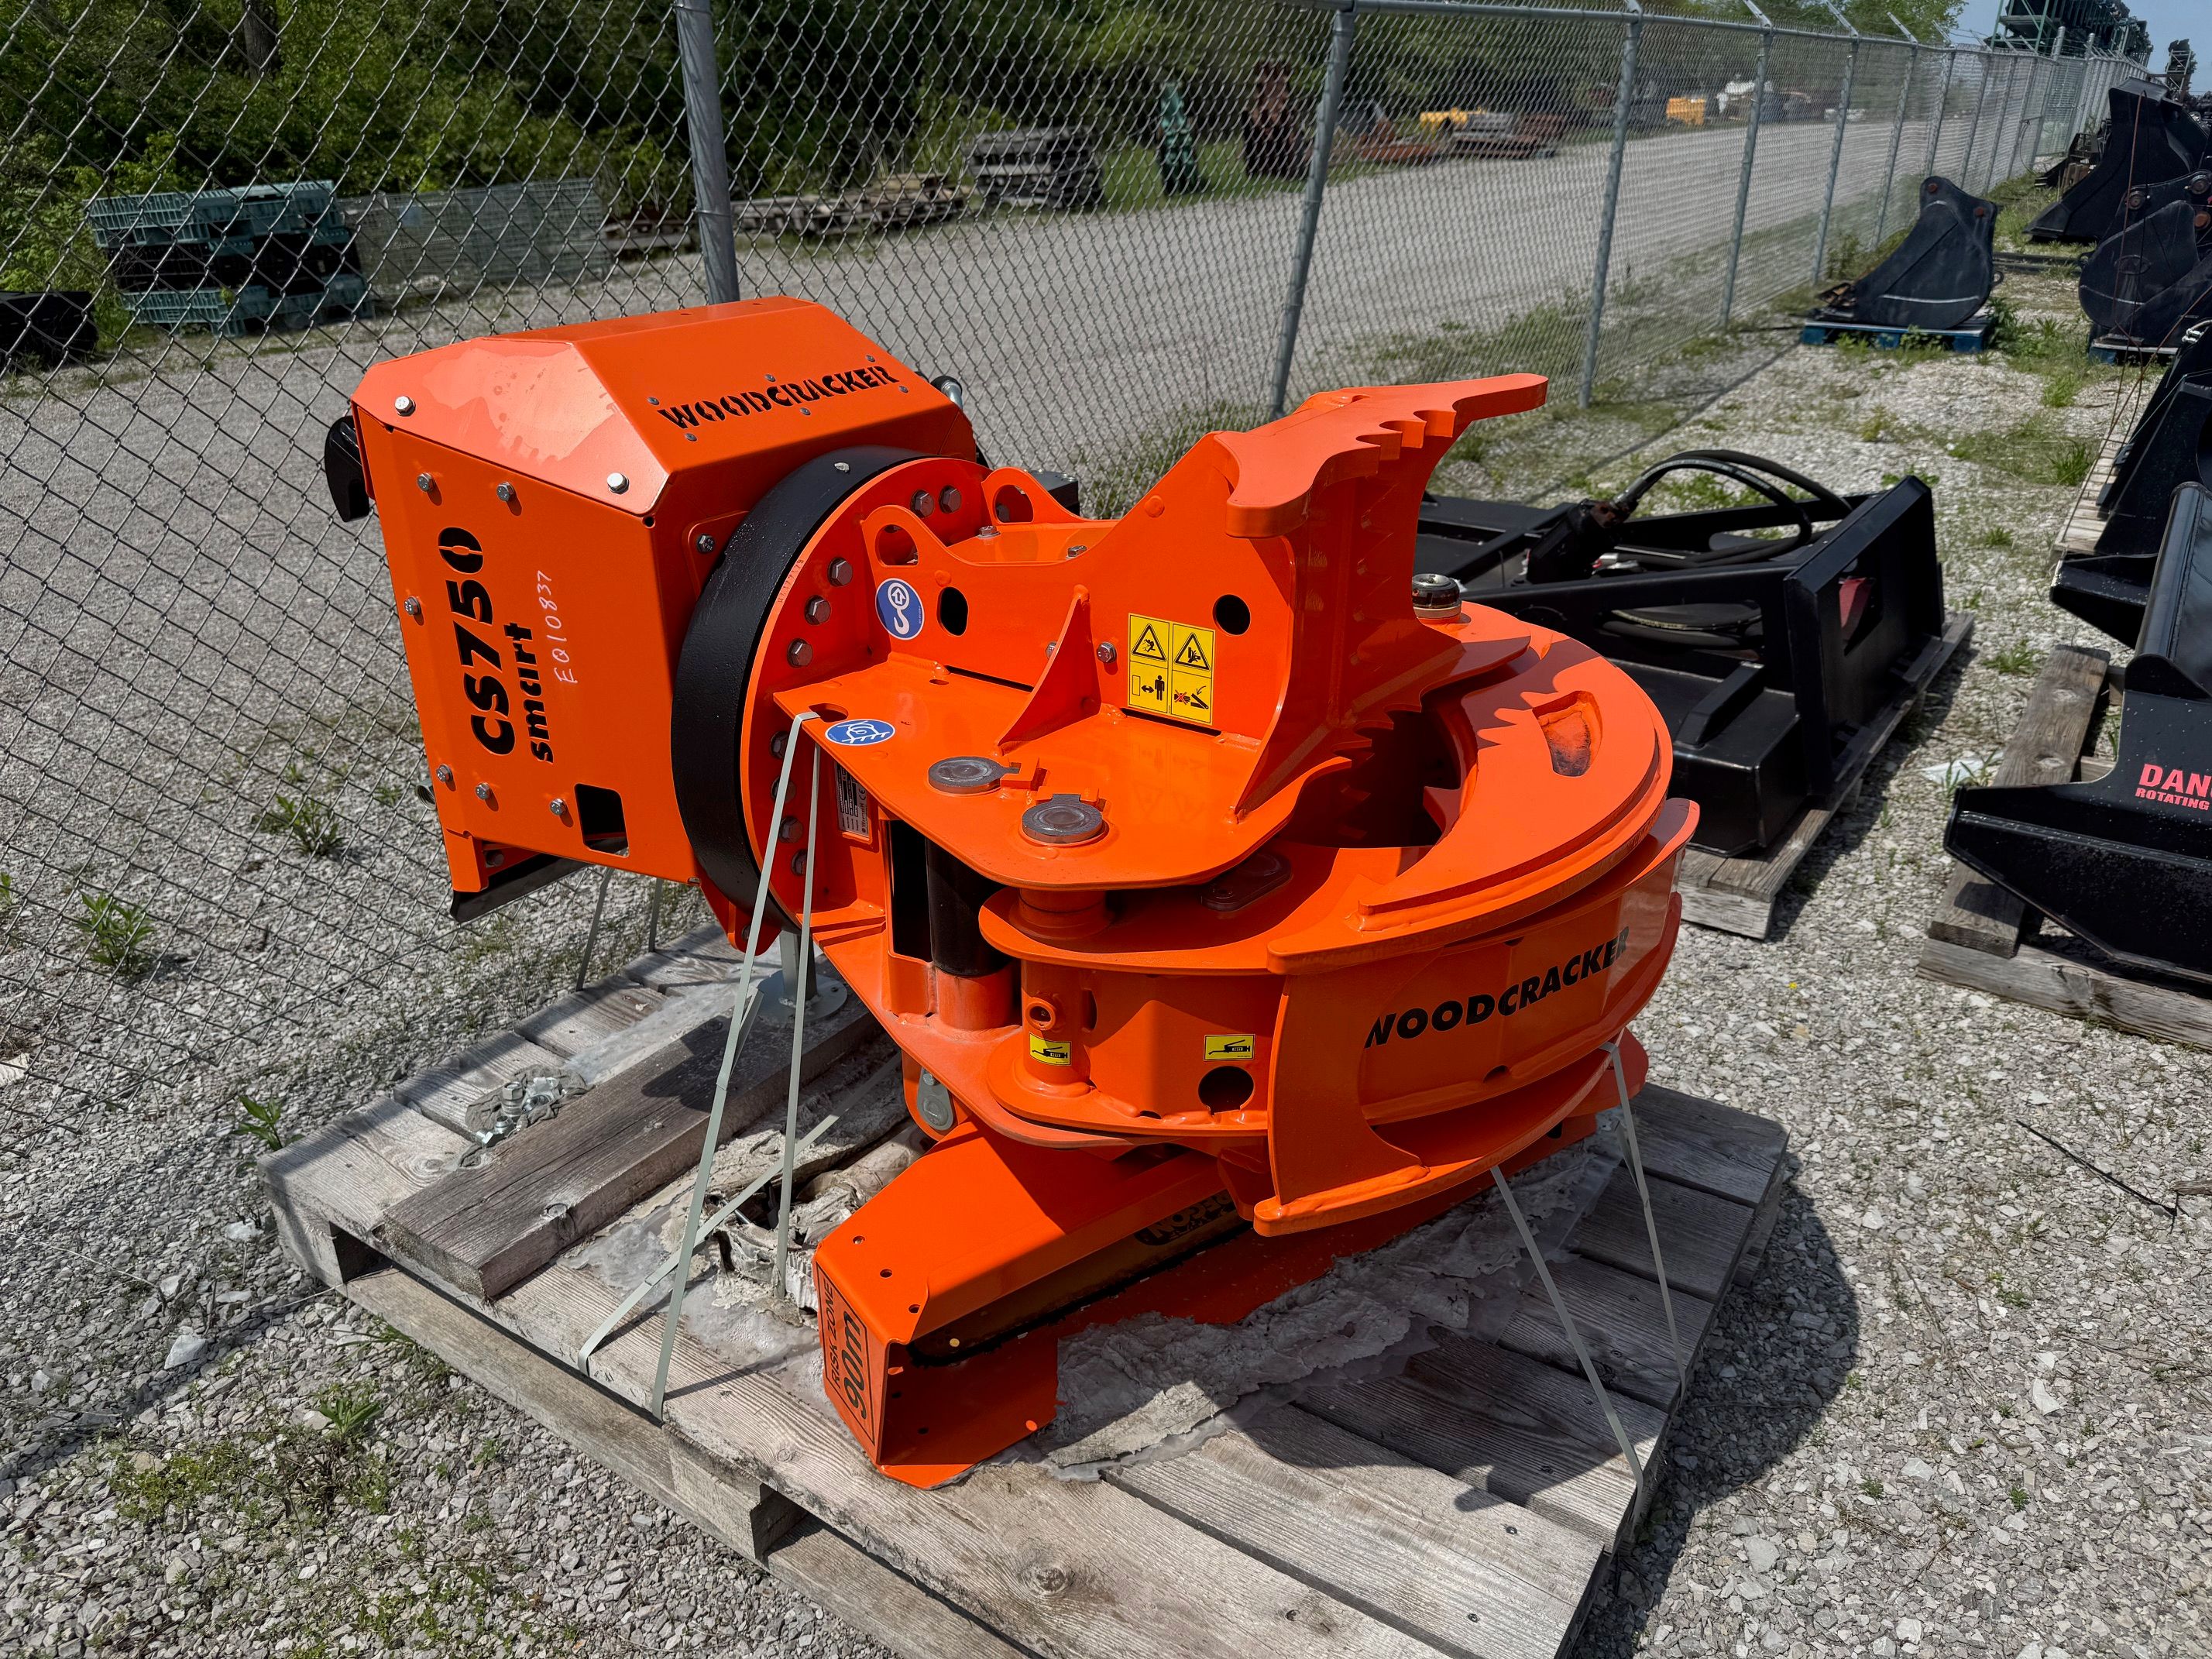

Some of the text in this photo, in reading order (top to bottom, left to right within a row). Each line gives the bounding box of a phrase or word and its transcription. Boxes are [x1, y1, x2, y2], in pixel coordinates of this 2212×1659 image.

[657, 366, 899, 429] WOODCRACKER
[438, 527, 516, 756] CS750
[503, 622, 555, 764] smart
[2135, 788, 2210, 810] ROTATING
[2138, 764, 2212, 798] DAN
[824, 1278, 840, 1389] RISK ZONE
[842, 1311, 867, 1419] 90m
